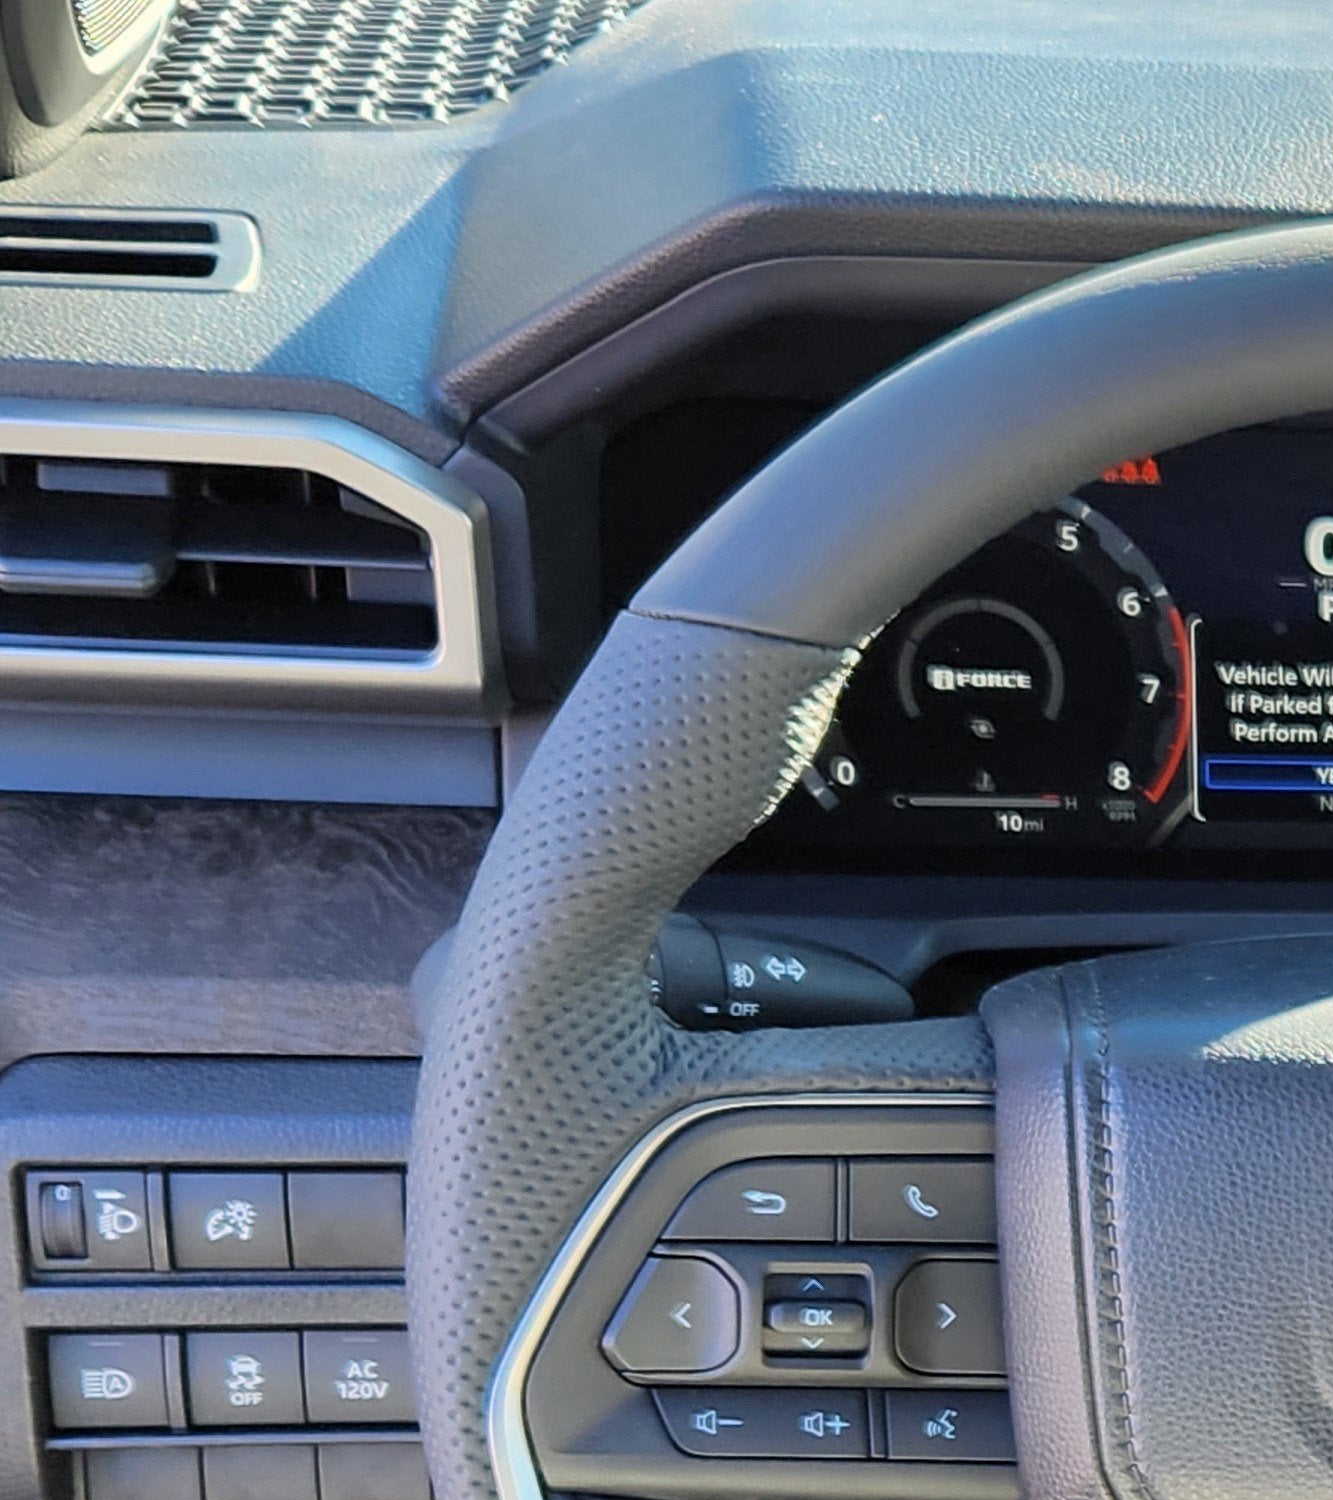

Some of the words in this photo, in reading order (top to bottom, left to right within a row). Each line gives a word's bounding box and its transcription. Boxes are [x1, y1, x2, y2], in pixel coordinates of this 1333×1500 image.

[1058, 522, 1080, 552] 5
[1119, 589, 1142, 617] 6
[1217, 661, 1298, 687] Vehicle
[1141, 679, 1161, 705] 7
[1228, 693, 1244, 714] If
[1249, 694, 1322, 715] Parked
[1231, 719, 1318, 743] Perform
[835, 760, 856, 786] 0
[1110, 764, 1132, 791] 8
[997, 813, 1024, 832] 10
[729, 1002, 760, 1017] OFF
[801, 1307, 833, 1326] OK
[346, 1361, 379, 1380] AC
[230, 1391, 263, 1406] OFF
[335, 1381, 389, 1401] 120V
